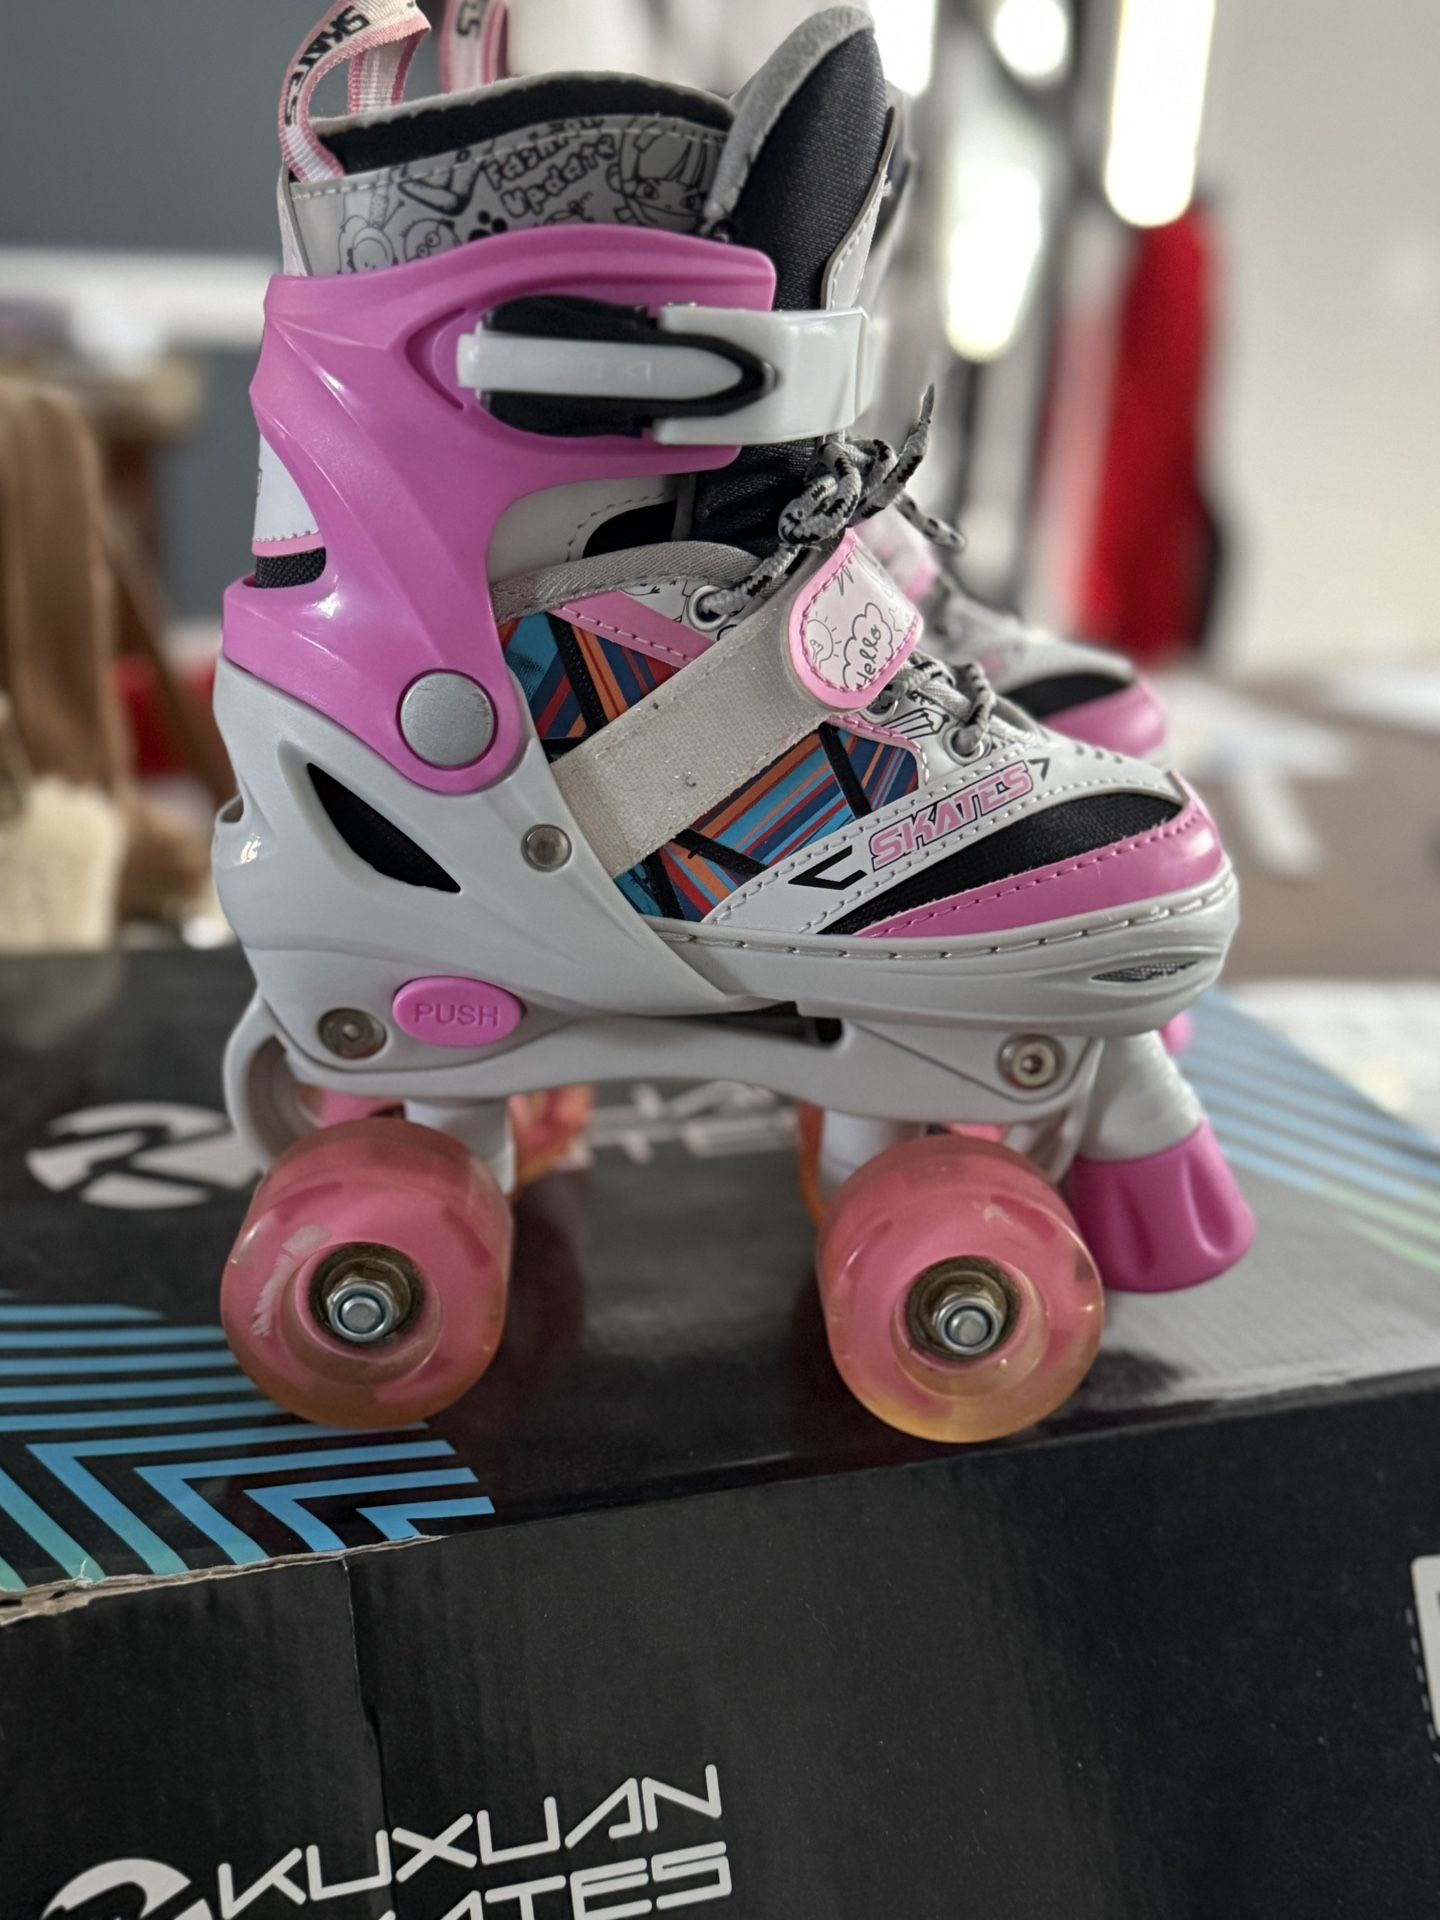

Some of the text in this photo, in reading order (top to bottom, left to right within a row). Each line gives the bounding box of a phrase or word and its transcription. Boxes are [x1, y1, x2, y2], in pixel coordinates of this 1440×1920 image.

[500, 133, 618, 218] Update
[868, 760, 1034, 872] SKATES
[414, 1002, 499, 1027] PUSH
[217, 1763, 722, 1920] KUXUAN
